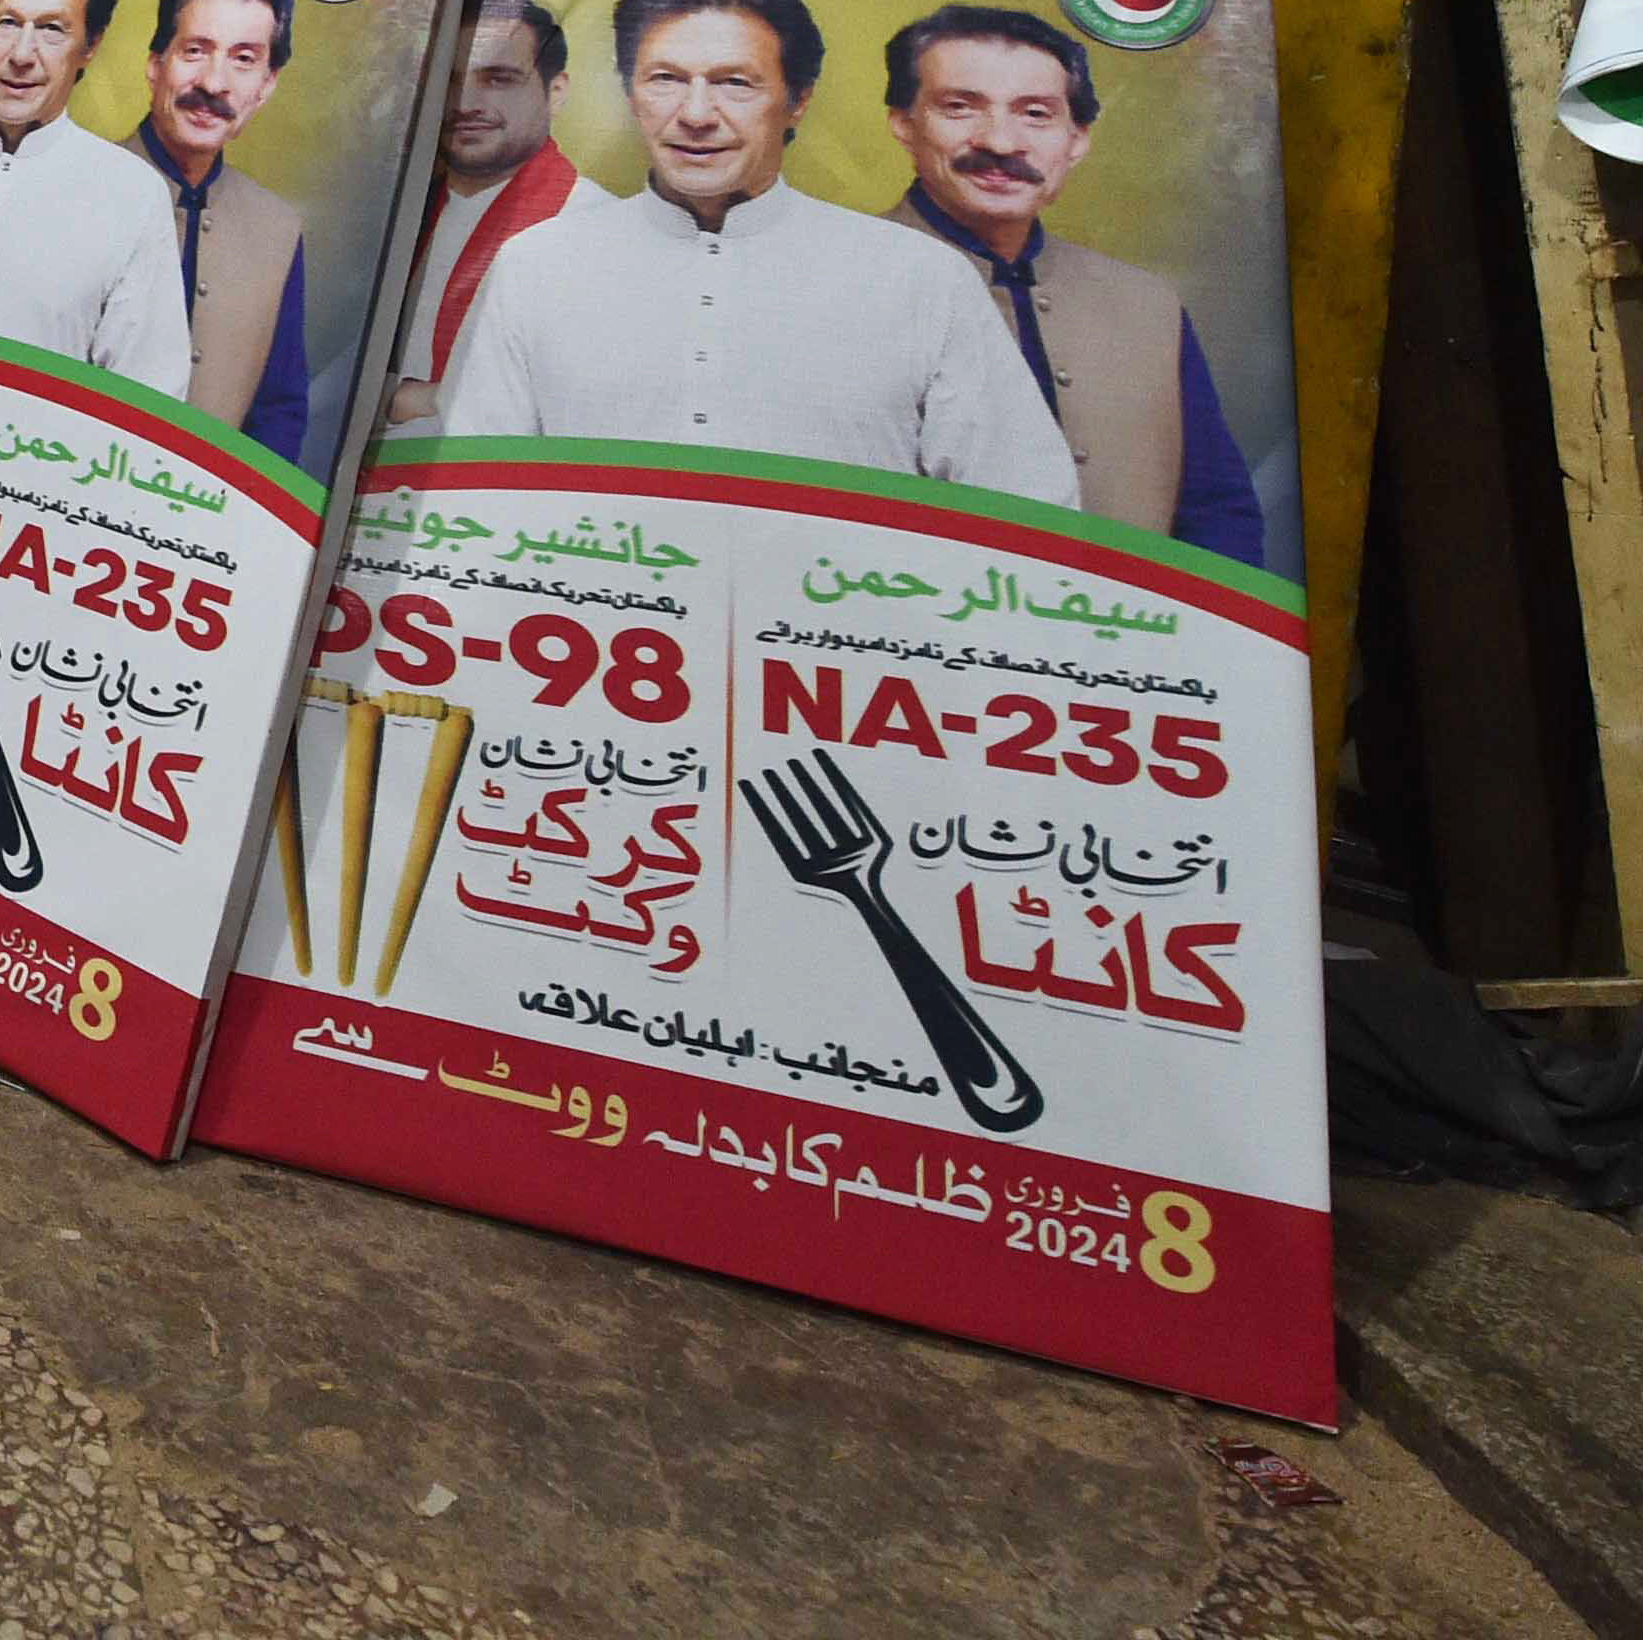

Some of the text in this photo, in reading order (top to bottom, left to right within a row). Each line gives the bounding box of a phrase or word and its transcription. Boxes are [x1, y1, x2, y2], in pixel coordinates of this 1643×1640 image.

[502, 520, 700, 581] جانشیر
[10, 640, 208, 731] انتخابی نشان
[307, 583, 691, 724] PS-98
[21, 697, 204, 845] کانٹا
[479, 736, 584, 770] نشان
[762, 657, 1229, 799] NA-235
[909, 814, 1228, 899] انتخابی نشان
[68, 957, 123, 1041] 8
[955, 883, 1245, 1032] کانٹا
[1006, 1210, 1128, 1273] 2024
[1139, 1190, 1216, 1294] 8
